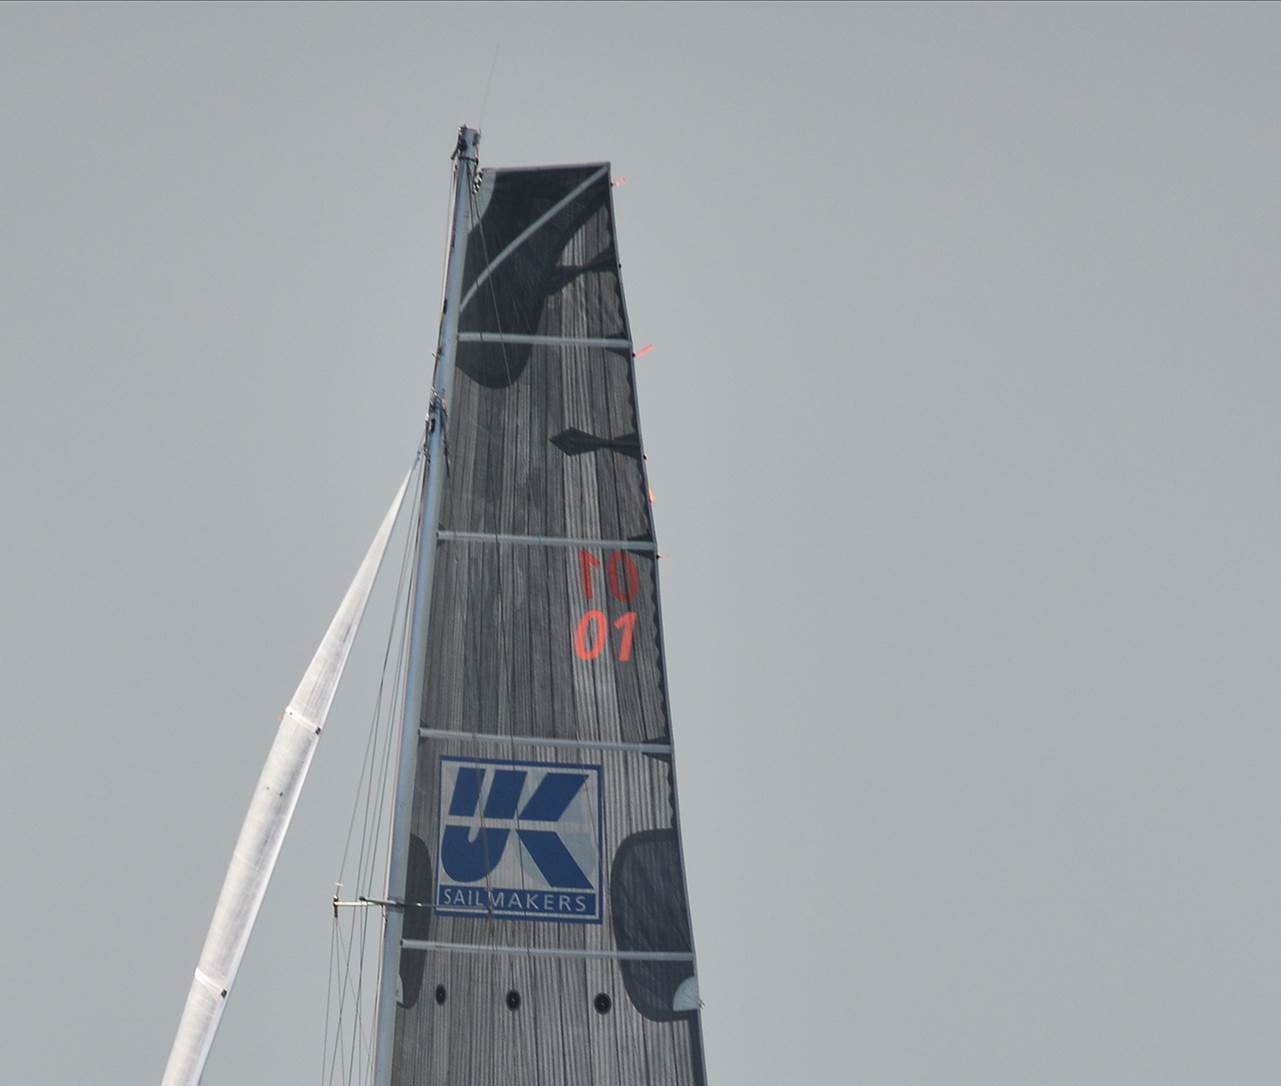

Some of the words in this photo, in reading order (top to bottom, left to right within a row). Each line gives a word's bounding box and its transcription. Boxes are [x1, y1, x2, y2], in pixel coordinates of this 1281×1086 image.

[575, 609, 637, 662] 01
[441, 766, 594, 889] UK
[443, 888, 586, 912] SAILMAKERS
